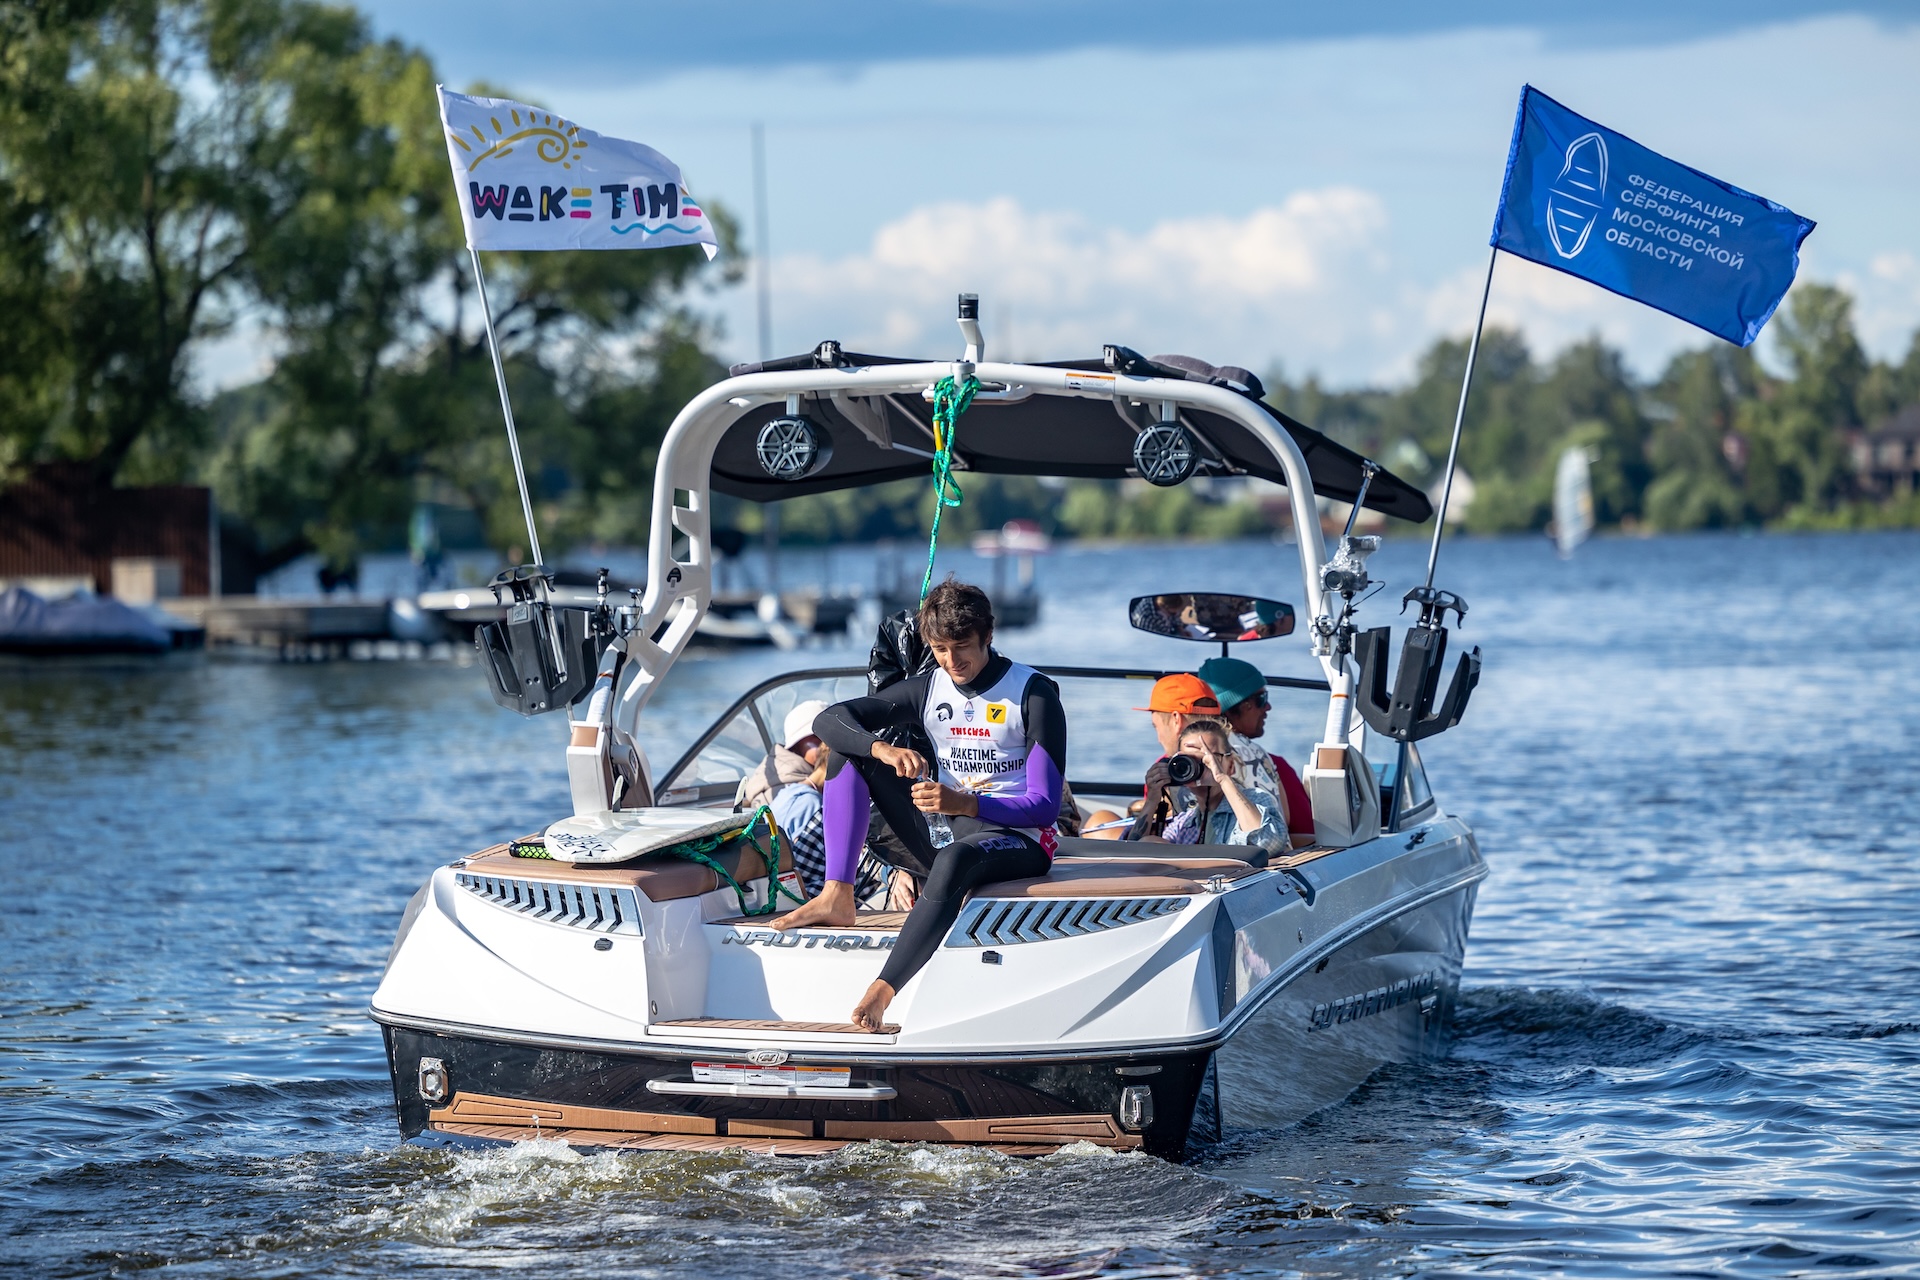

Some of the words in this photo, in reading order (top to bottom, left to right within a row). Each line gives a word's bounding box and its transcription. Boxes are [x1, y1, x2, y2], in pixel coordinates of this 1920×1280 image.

[469, 181, 592, 221] WAKE
[1620, 189, 1721, 238] СЁРФИНГА
[1628, 174, 1744, 227] ФЕДЕРАЦИЯ
[1605, 228, 1694, 271] ОБЛАСТИ
[1612, 207, 1745, 271] МОСКОВСКОЙ
[950, 747, 997, 761] WAKETIME
[952, 758, 1025, 774] CHAMPIONSHIP
